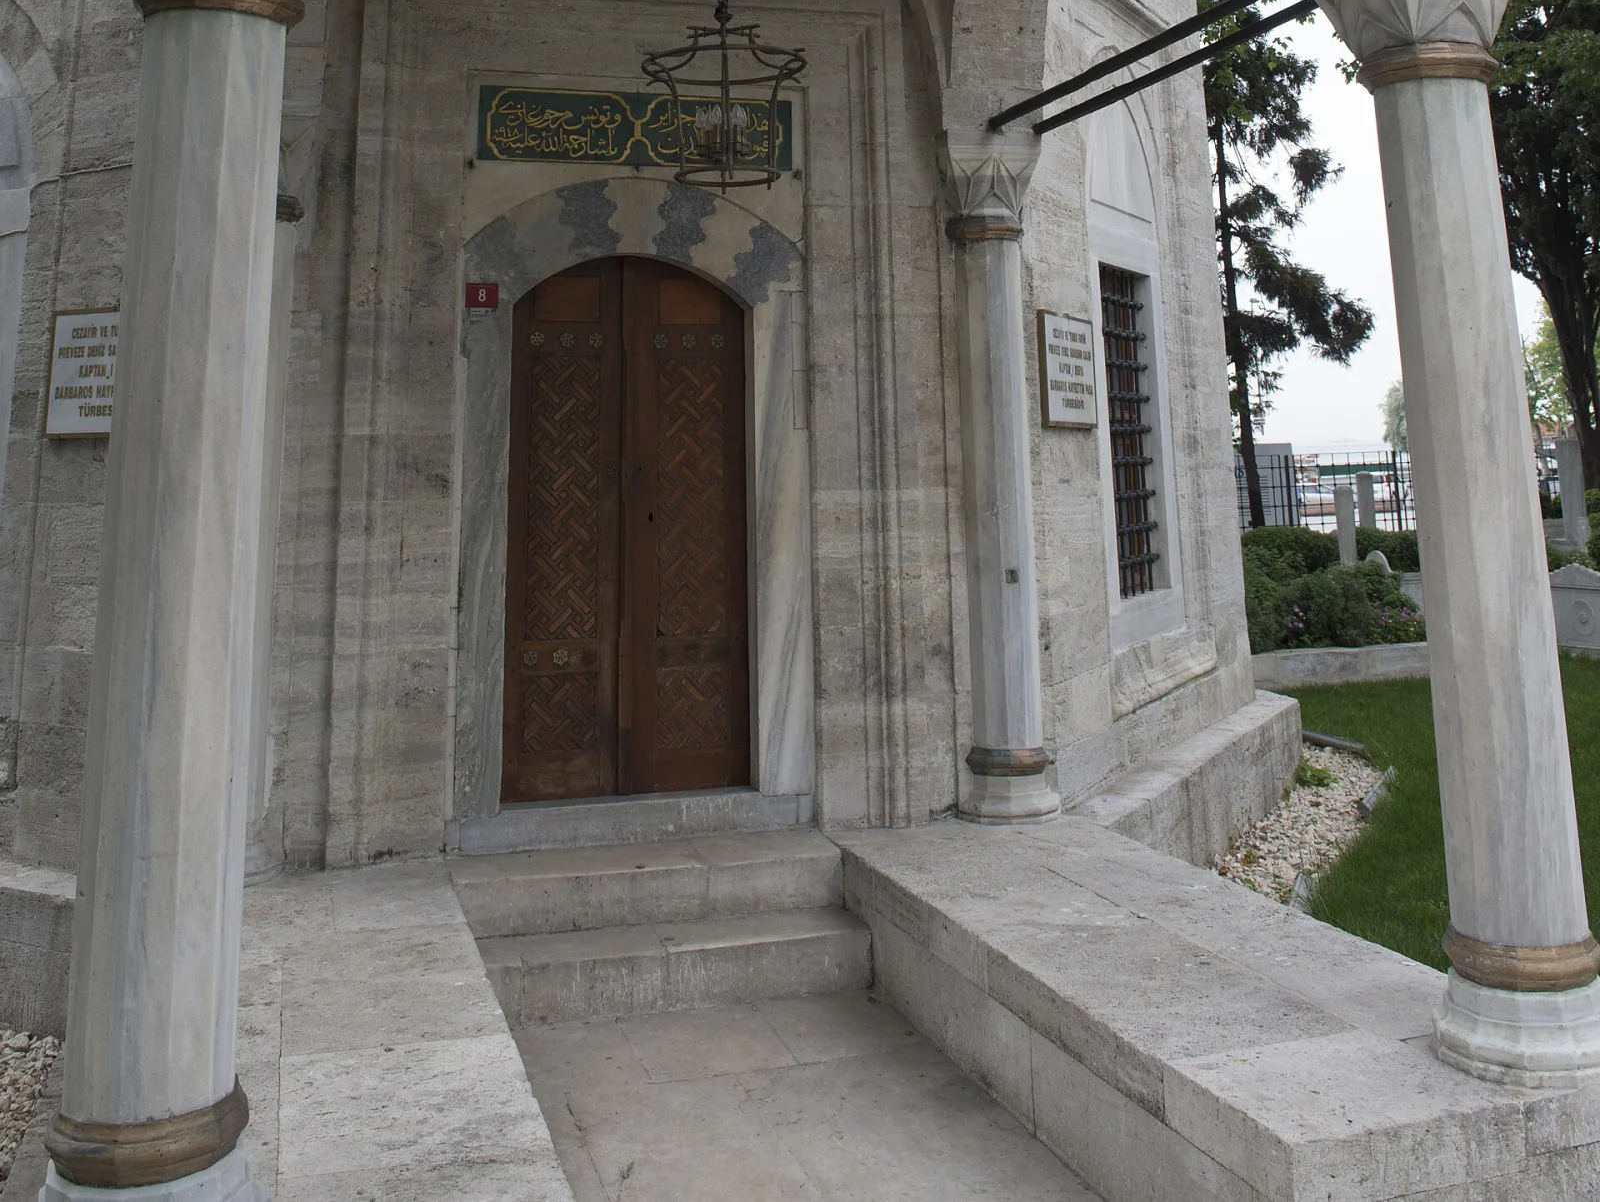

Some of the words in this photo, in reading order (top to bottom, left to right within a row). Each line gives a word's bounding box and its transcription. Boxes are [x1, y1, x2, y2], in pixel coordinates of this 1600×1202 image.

[479, 289, 486, 302] 8
[72, 324, 97, 339] CEZAYİR
[100, 326, 108, 338] VE
[58, 345, 85, 359] PREVEZE
[87, 343, 106, 358] DENİZ
[54, 385, 94, 400] BARBAROS
